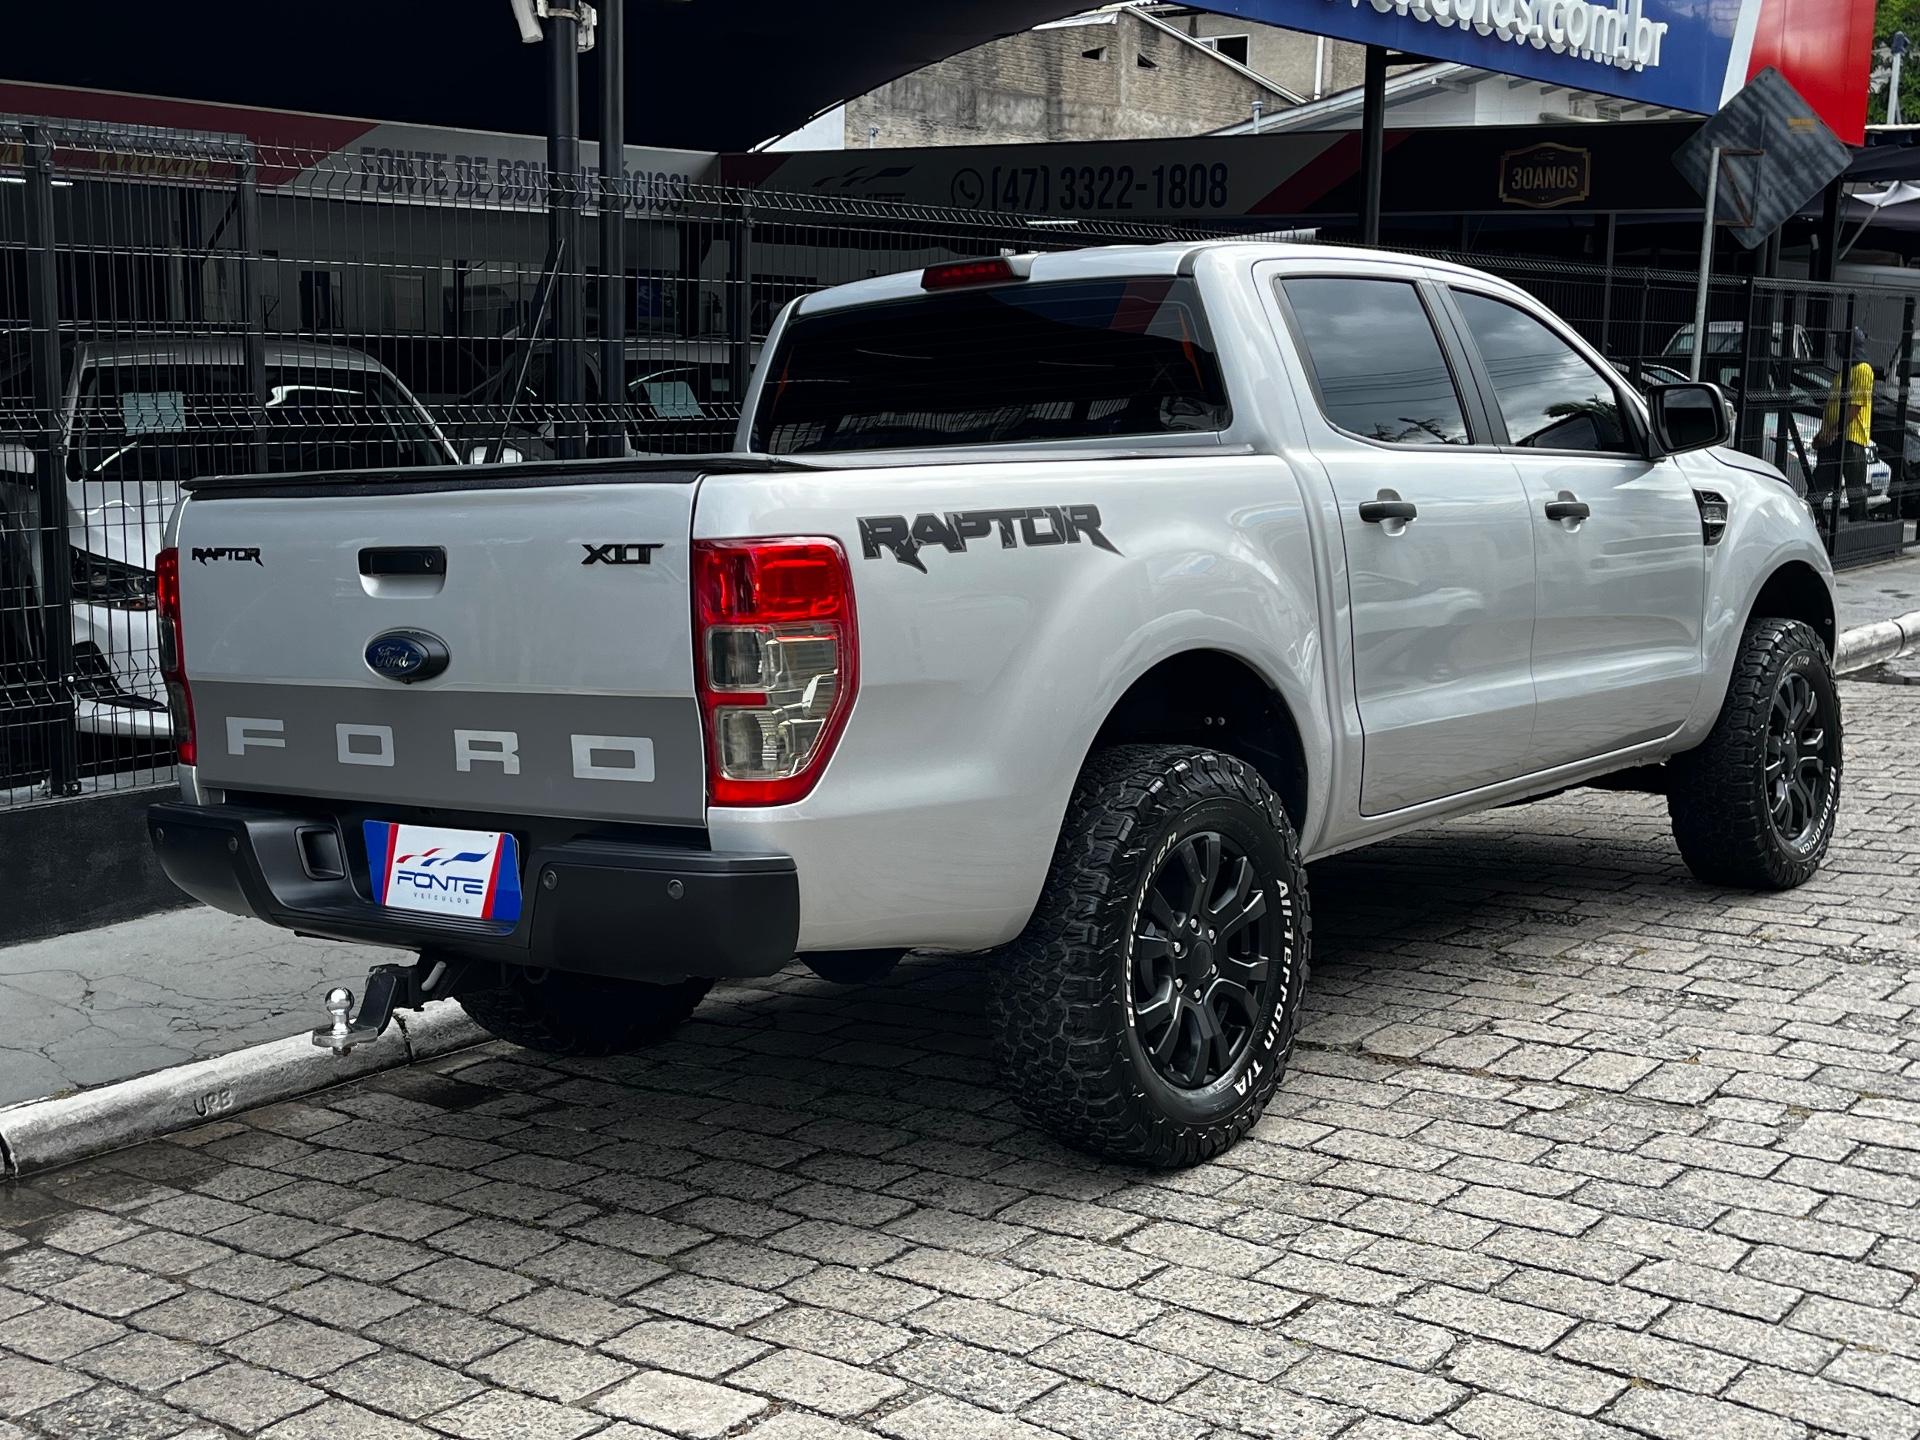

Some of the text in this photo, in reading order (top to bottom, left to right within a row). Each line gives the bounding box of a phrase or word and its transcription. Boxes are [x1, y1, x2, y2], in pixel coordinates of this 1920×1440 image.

[360, 147, 448, 195] FONTE
[454, 155, 489, 199] DE
[497, 159, 549, 204] BON
[992, 162, 1229, 212] (47) 3322-1808
[191, 547, 265, 568] RAPTOR
[581, 543, 665, 565] XLT
[856, 503, 1126, 574] RAPTOR
[375, 645, 409, 668] Ford
[225, 716, 655, 783] FORD
[397, 869, 484, 896] FONTE
[1233, 879, 1292, 1096] All-Terrain T/A
